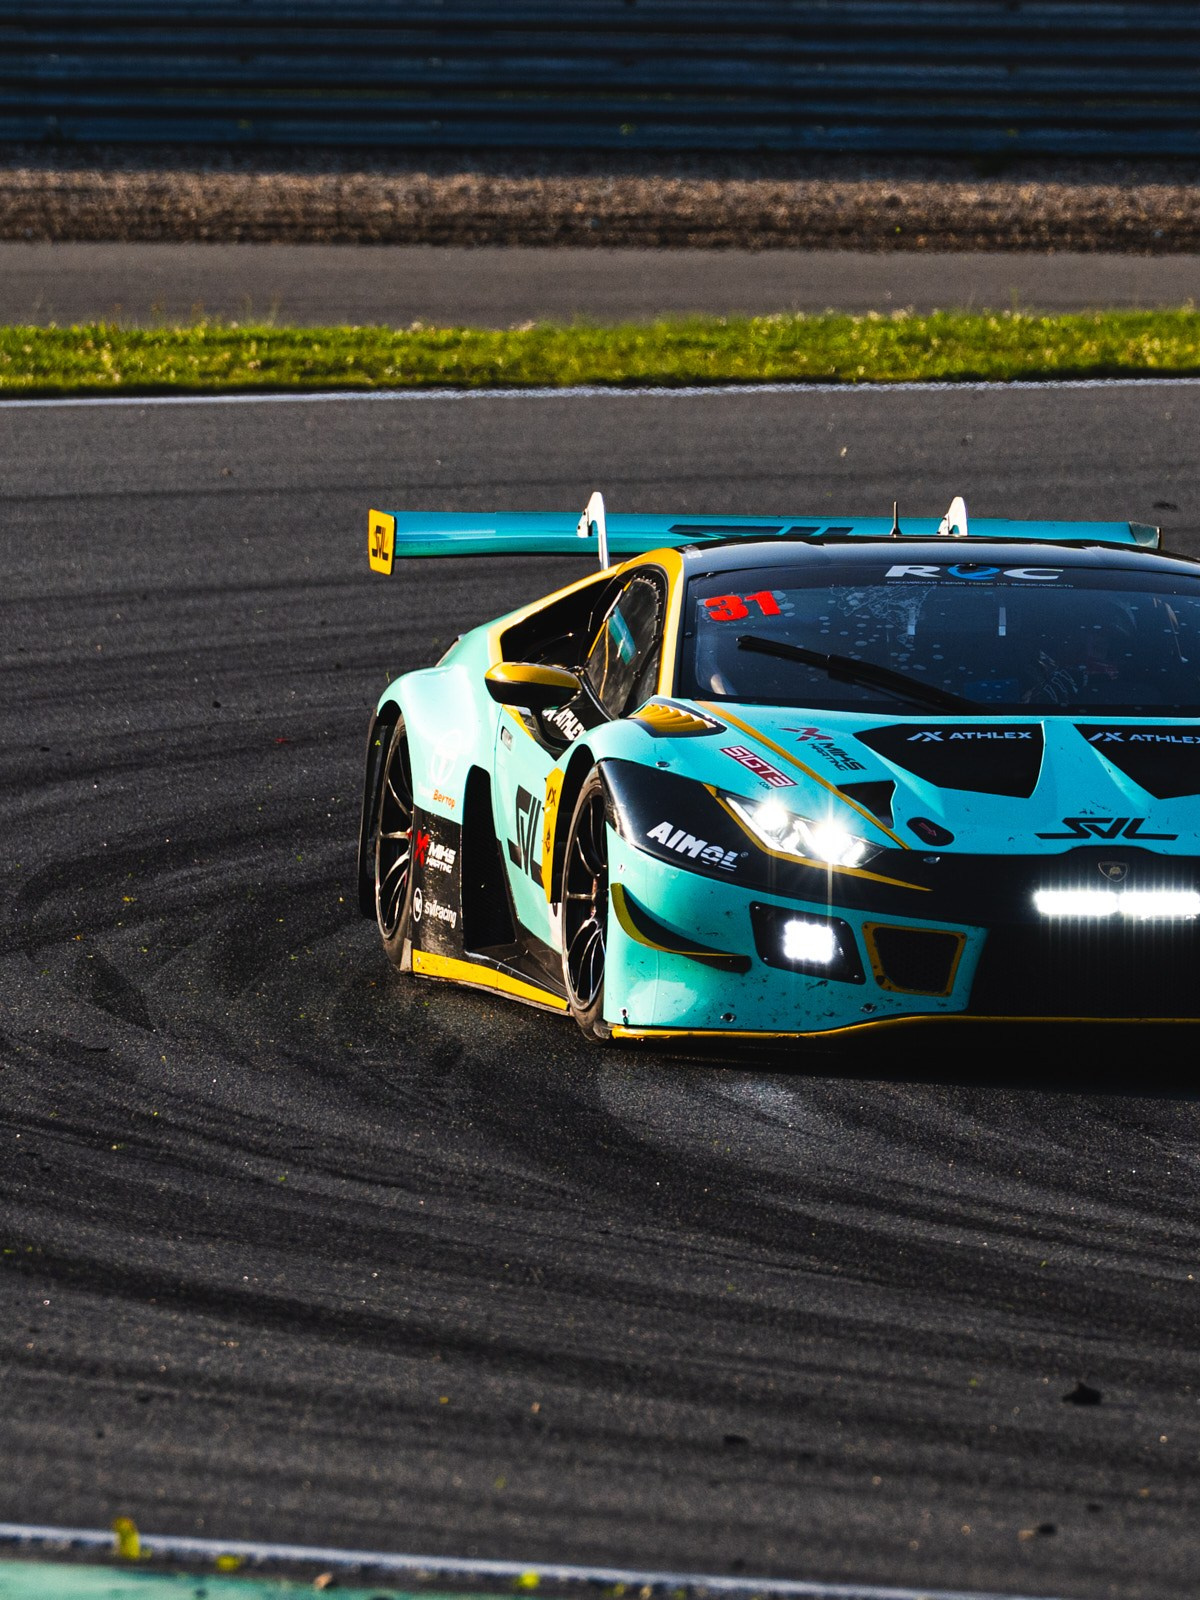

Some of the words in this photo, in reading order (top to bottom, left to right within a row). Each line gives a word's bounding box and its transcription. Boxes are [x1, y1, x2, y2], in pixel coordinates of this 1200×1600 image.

[704, 590, 781, 621] 31
[950, 731, 1032, 740] ATHLEX
[1034, 817, 1179, 841] SVL
